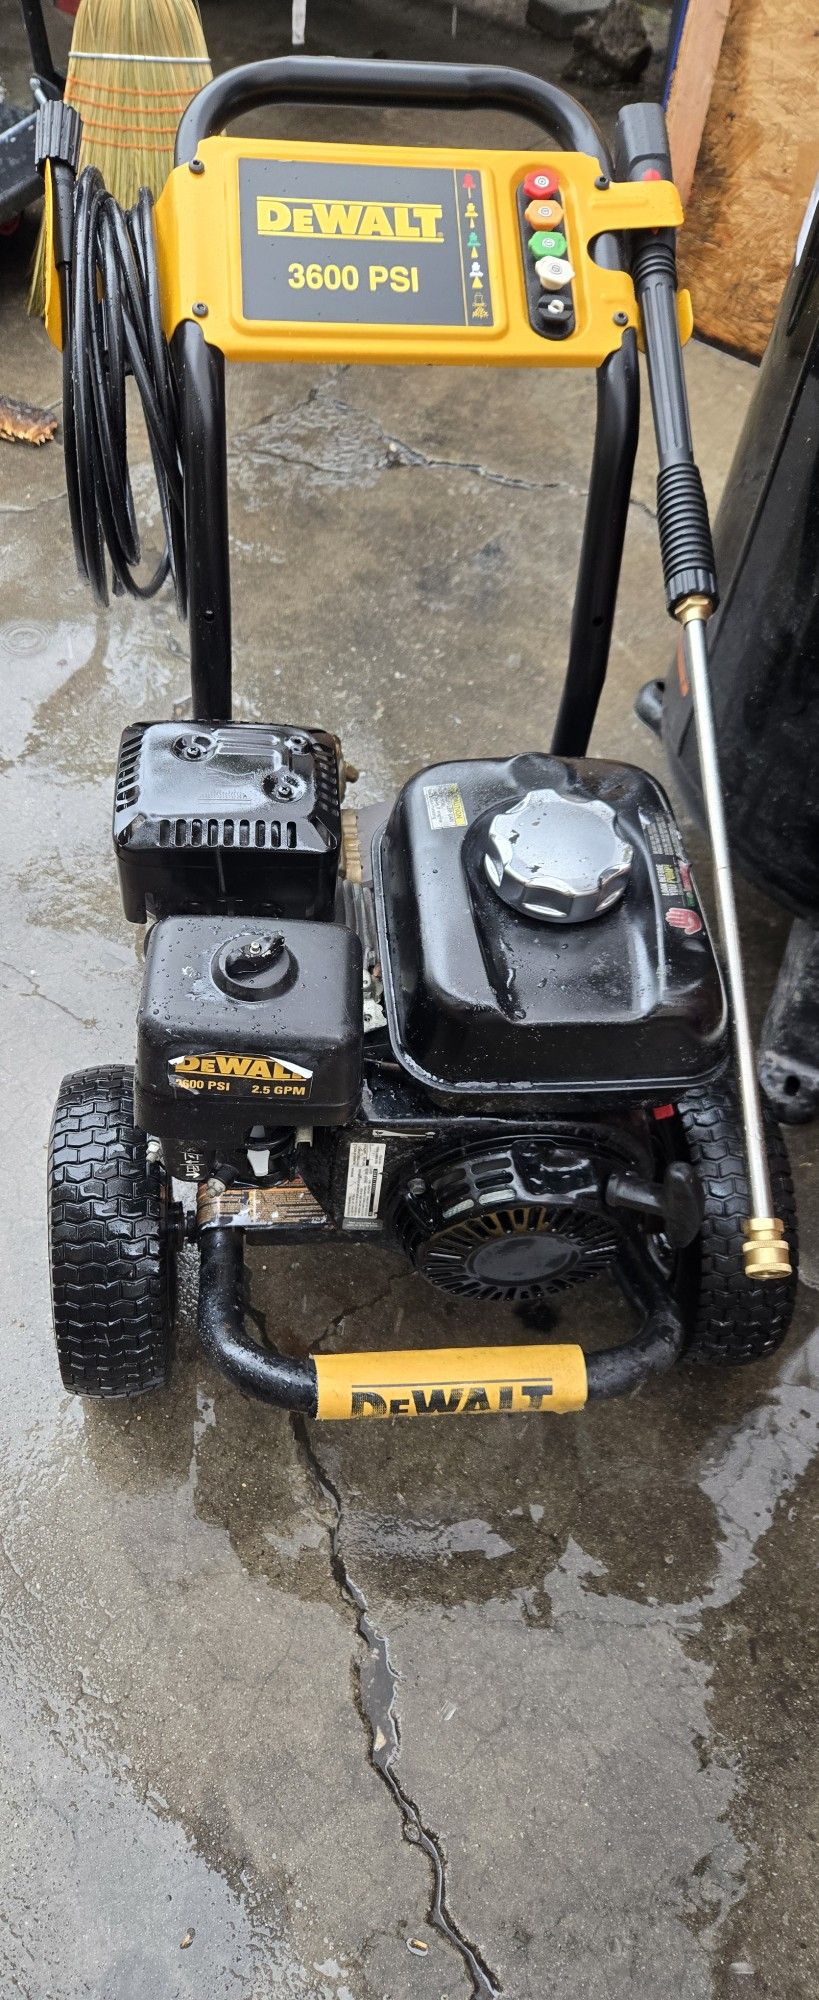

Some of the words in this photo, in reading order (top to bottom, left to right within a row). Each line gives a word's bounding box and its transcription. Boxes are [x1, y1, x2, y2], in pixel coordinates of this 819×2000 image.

[288, 263, 359, 291] 3600
[369, 265, 419, 293] PSI
[175, 1055, 303, 1079] DEWAL
[208, 1080, 230, 1091] PSI
[252, 1085, 271, 1094] 2.5
[274, 1085, 306, 1095] GPM
